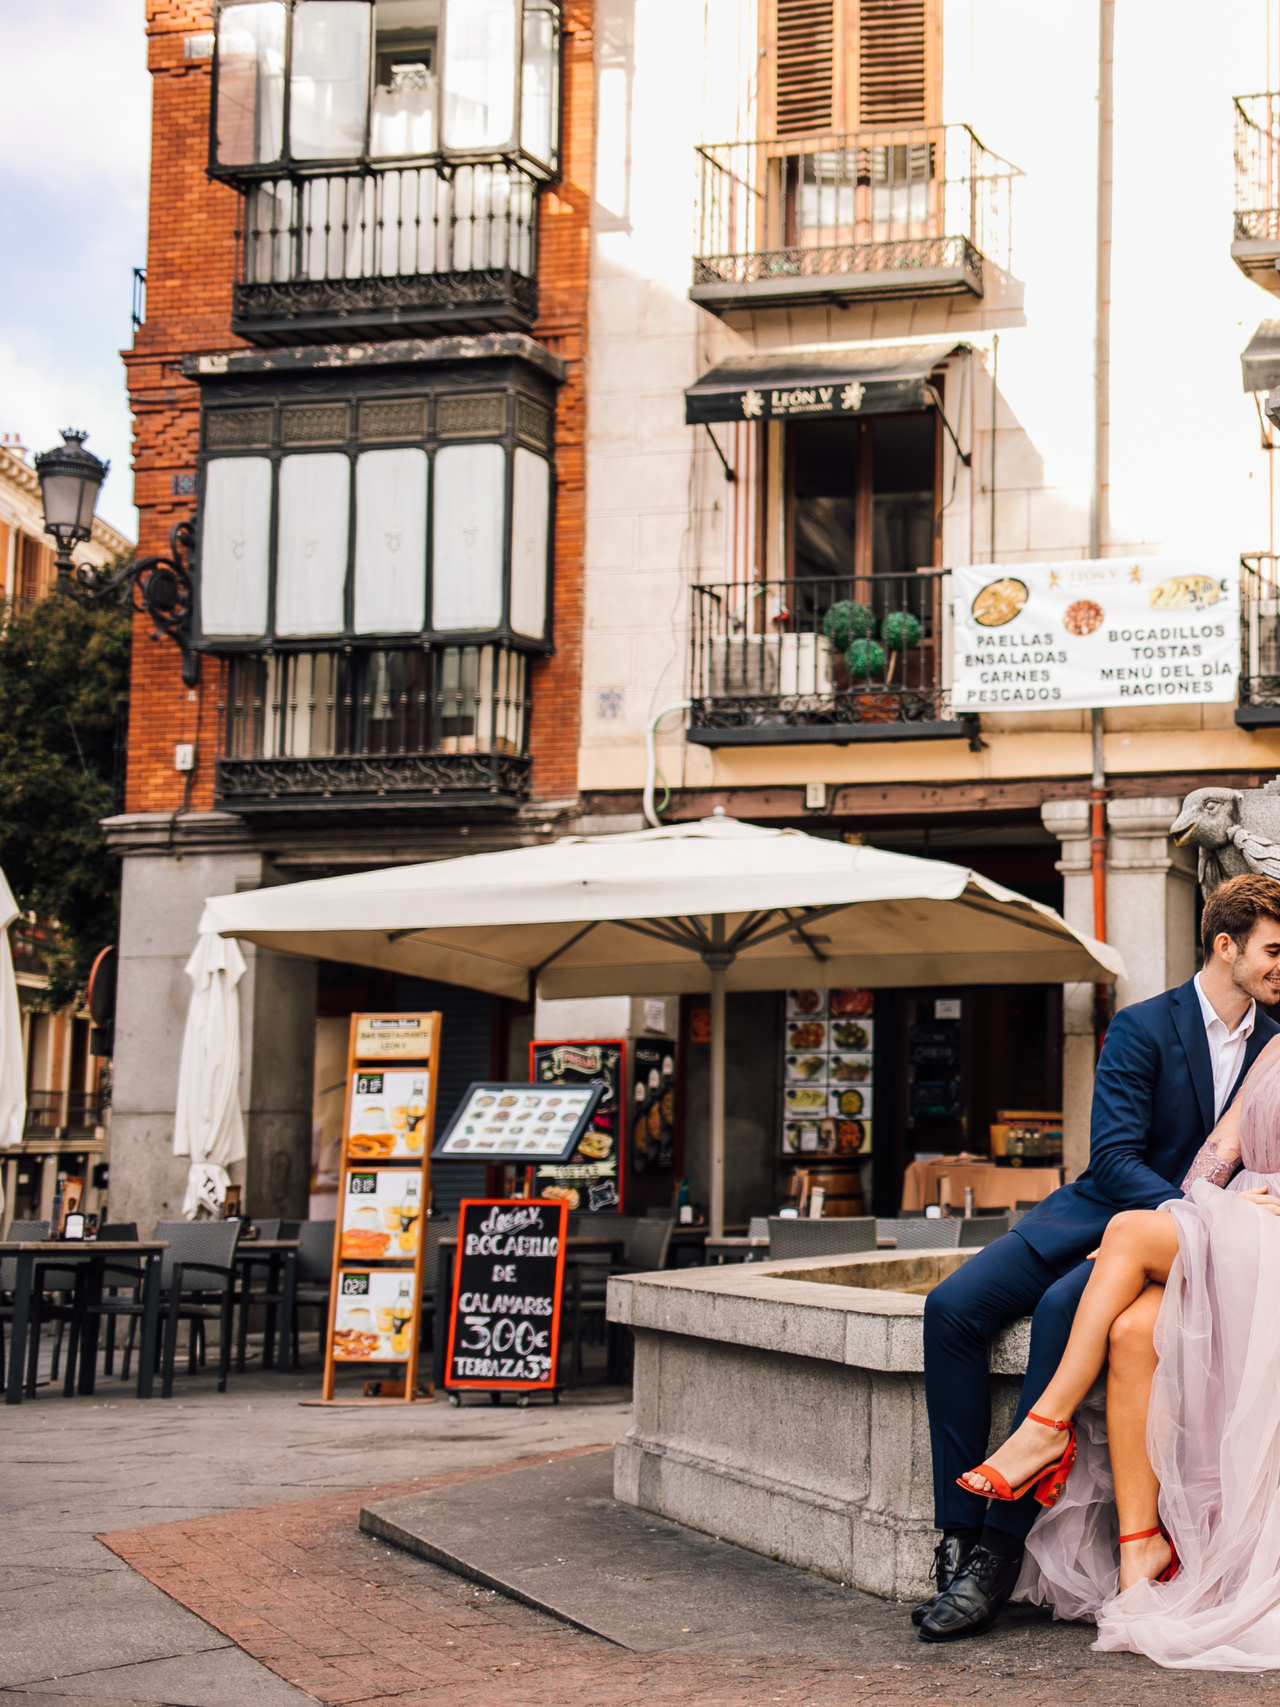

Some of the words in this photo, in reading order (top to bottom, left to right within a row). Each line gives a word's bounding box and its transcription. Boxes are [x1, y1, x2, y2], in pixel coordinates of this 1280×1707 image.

[818, 387, 833, 402] V
[976, 633, 1054, 648] PAELLAS
[1108, 625, 1225, 642] BOCADILLOS
[965, 651, 1068, 667] ENSALADAS
[1131, 645, 1202, 660] TOSTAS
[980, 670, 1051, 685] CARNES
[1100, 663, 1152, 681] MENÚ
[1161, 665, 1194, 678] DEL
[1202, 662, 1233, 677] DÍA
[967, 687, 1062, 702] PESCADOS
[1119, 681, 1214, 698] RACIONES
[491, 1264, 518, 1283] DE
[459, 1292, 553, 1317] CALAMARES
